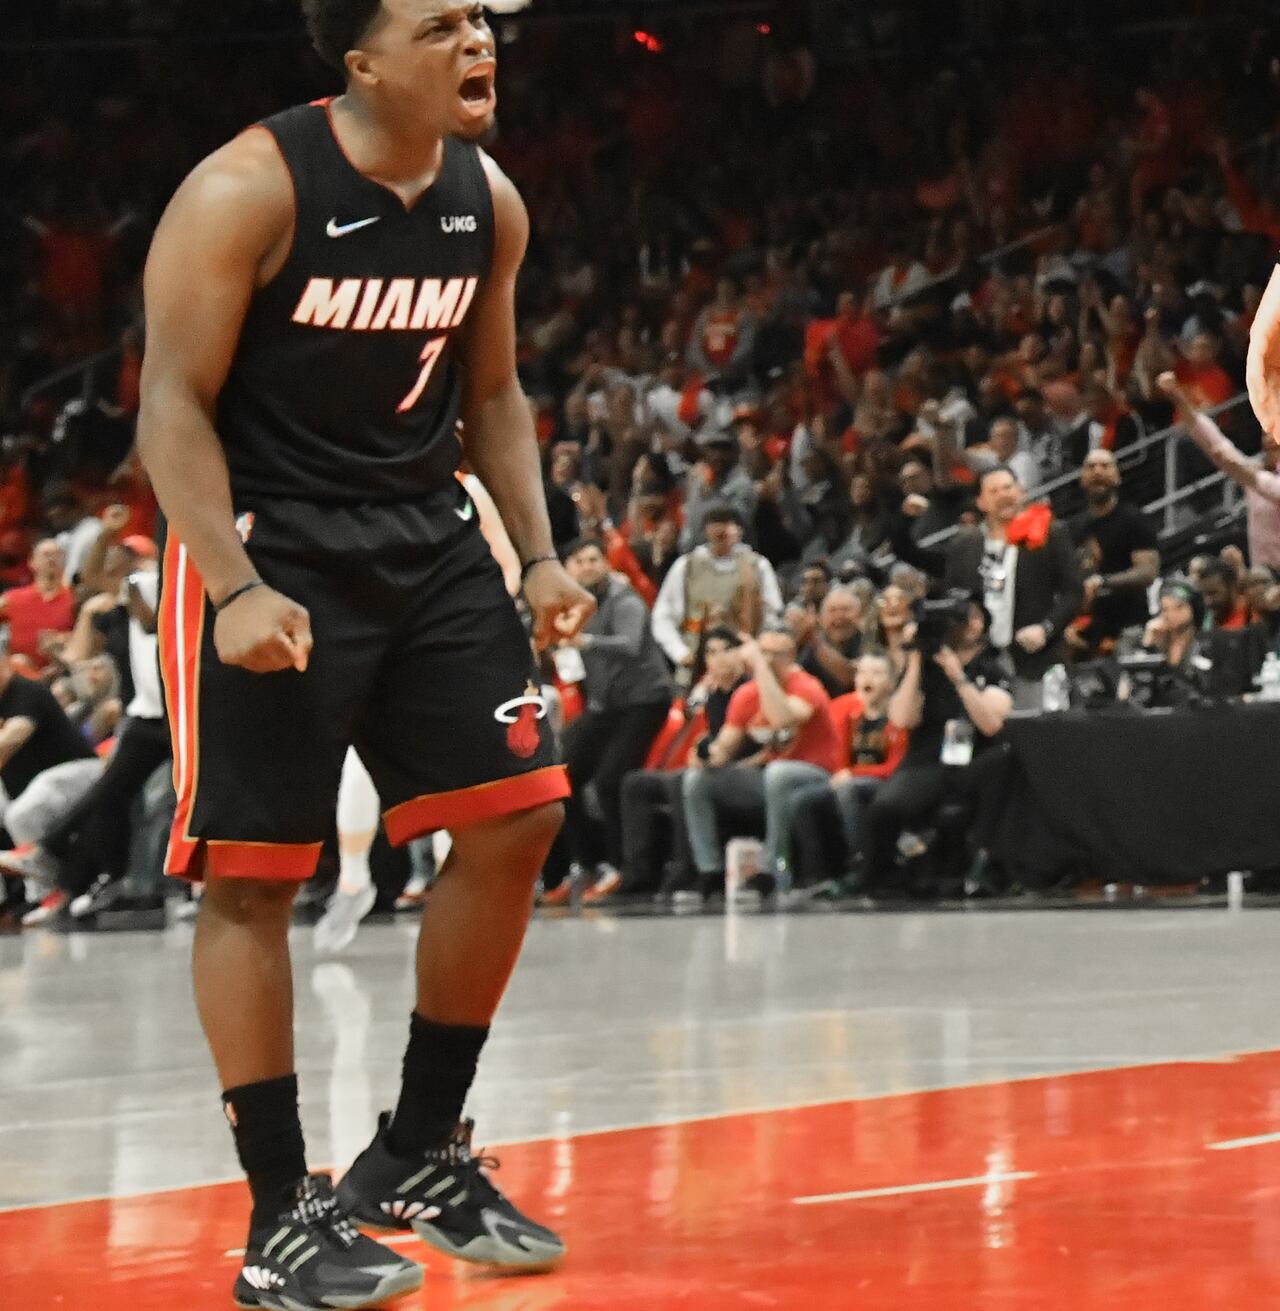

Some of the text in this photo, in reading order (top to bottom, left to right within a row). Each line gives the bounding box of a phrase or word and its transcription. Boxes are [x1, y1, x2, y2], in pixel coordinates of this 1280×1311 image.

[440, 215, 477, 233] UKG
[292, 277, 480, 330] MIAMI
[395, 335, 448, 414] 7
